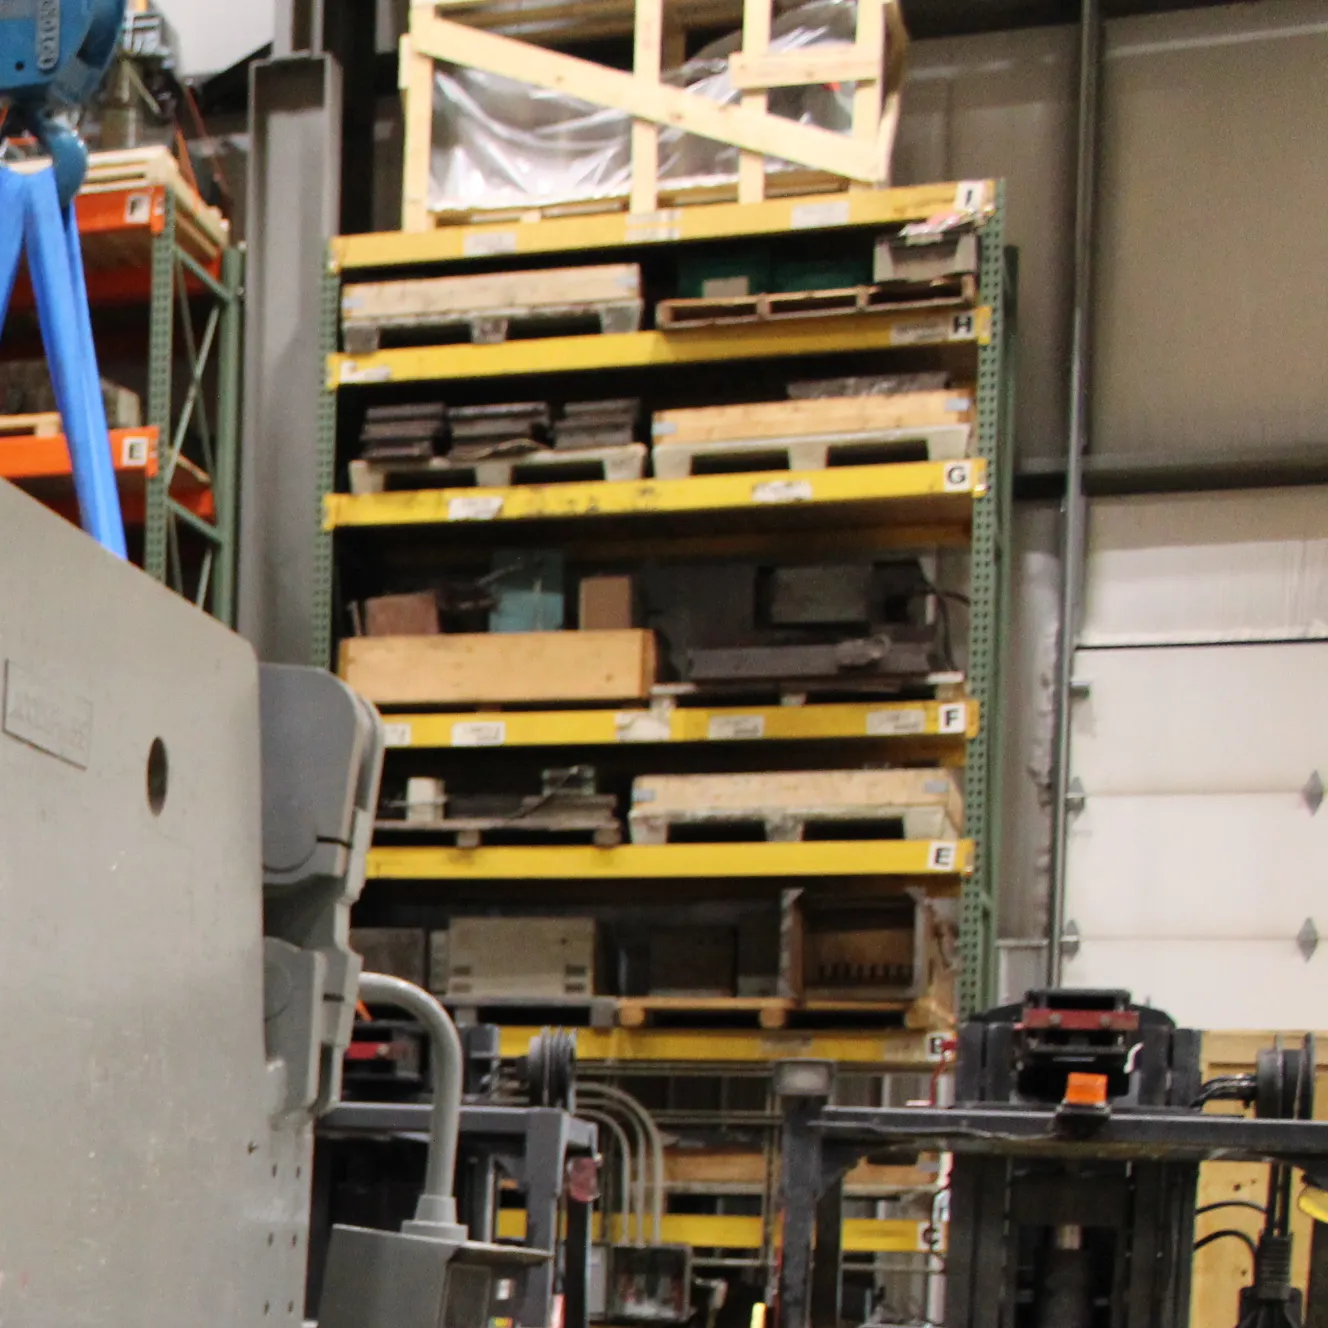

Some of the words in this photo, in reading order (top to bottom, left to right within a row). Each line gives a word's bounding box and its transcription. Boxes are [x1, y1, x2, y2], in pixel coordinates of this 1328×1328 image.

[953, 314, 973, 334] H
[128, 442, 142, 460] E
[947, 465, 966, 485] G
[945, 708, 959, 727] F
[935, 847, 951, 866] E
